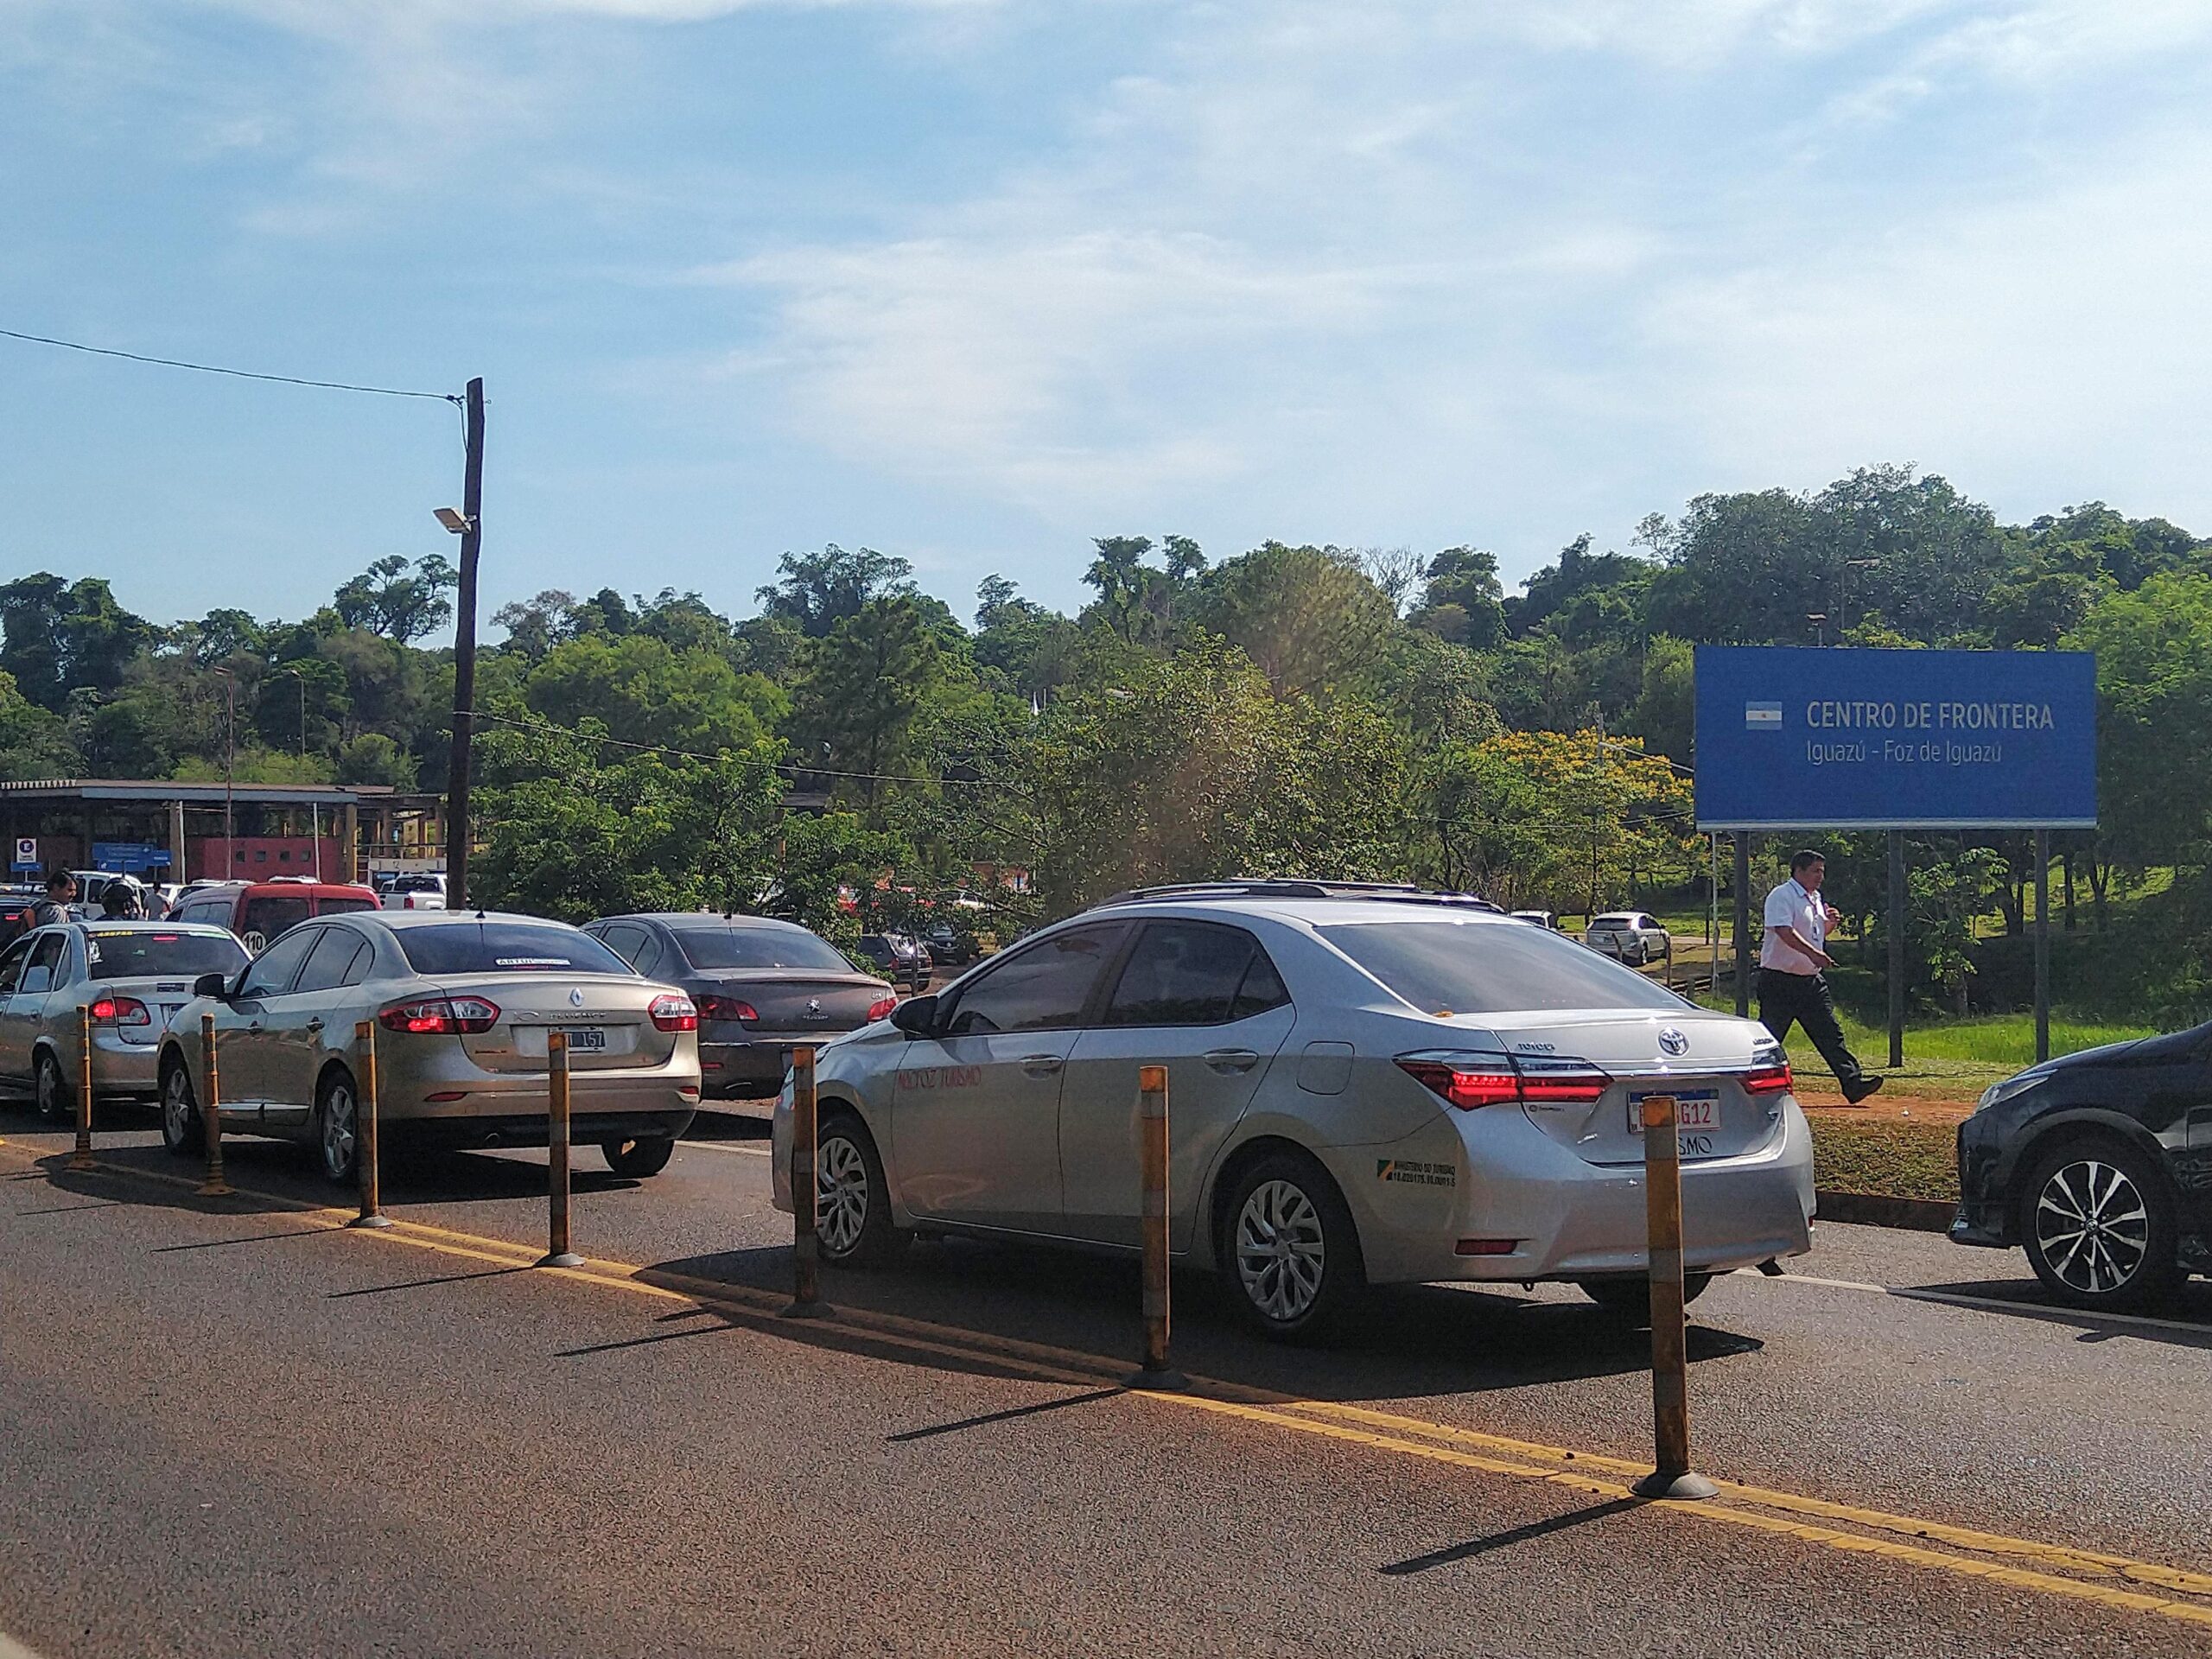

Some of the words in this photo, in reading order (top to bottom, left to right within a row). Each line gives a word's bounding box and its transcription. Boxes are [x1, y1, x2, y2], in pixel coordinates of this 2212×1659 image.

[1807, 701, 1897, 728] CENTRO
[1904, 702, 1932, 728] DE
[1938, 702, 2055, 729] FRONTERA
[1807, 739, 1866, 766] Iguazú
[1885, 740, 1915, 762] Foz
[1919, 740, 1941, 762] de
[1946, 741, 2002, 766] Iguazú
[244, 934, 263, 950] 110
[583, 1033, 602, 1046] 157
